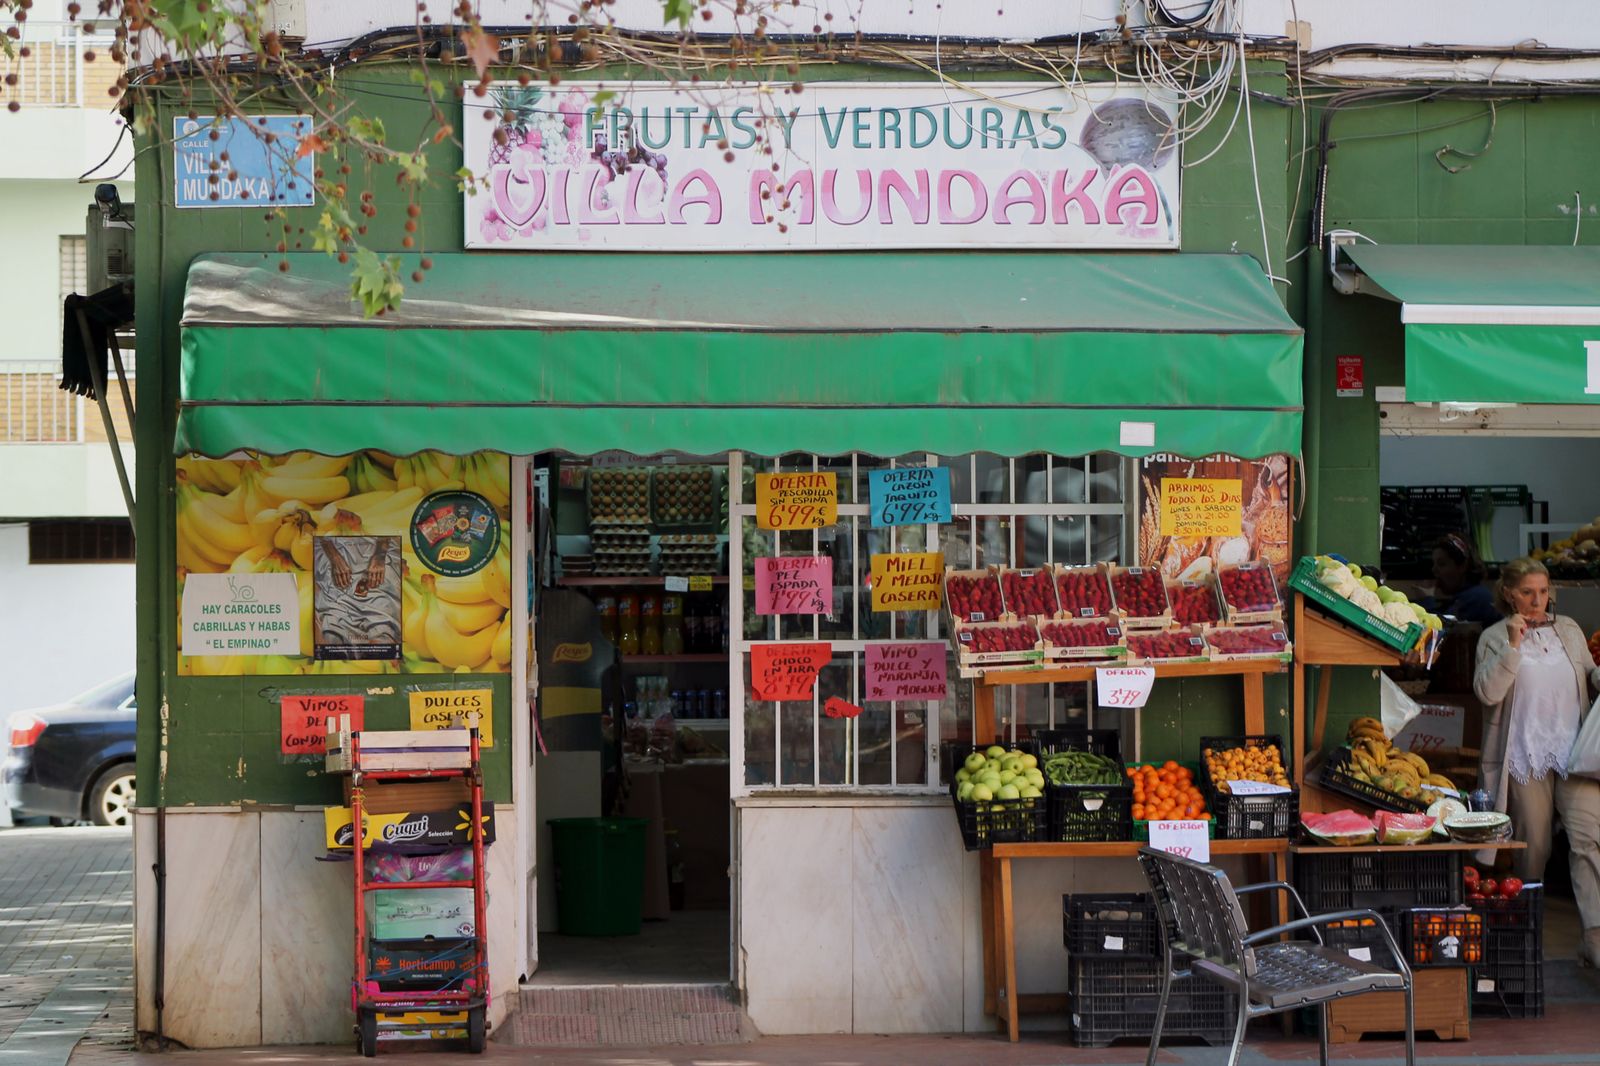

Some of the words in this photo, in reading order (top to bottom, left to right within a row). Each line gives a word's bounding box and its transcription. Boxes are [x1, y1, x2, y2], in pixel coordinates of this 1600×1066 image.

[585, 106, 757, 150] FRUTAS
[777, 107, 800, 150] Y
[818, 105, 1067, 150] VERDURAS
[182, 140, 209, 148] CALLE
[183, 152, 231, 174] VILLA
[184, 178, 270, 201] MUNDAKA
[494, 168, 722, 226] VILLA
[749, 163, 1160, 225] MUNDAKA
[770, 475, 827, 490] OFERTA
[884, 469, 934, 483] OFERTA
[892, 480, 931, 492] CAZON
[1168, 483, 1214, 494] ABRIMOS
[779, 489, 833, 497] PESCADILLA
[883, 490, 937, 503] TAQUITO
[1168, 496, 1196, 505] TODOS
[1201, 494, 1215, 504] LOS
[769, 505, 815, 527] 6'99
[882, 502, 925, 524] 6'99
[1170, 506, 1190, 514] LUNES
[768, 558, 818, 571] OFERTA
[887, 557, 932, 572] MIEL
[776, 570, 801, 580] PEZ
[770, 580, 818, 592] ESPADA
[876, 576, 882, 588] Y
[881, 590, 938, 604] CASERA
[202, 605, 221, 614] HAY
[224, 604, 281, 614] CARACOLES
[193, 622, 246, 631] CABRILLAS
[249, 622, 255, 631] Y
[258, 621, 291, 631] HABAS
[213, 639, 225, 649] EL
[228, 639, 271, 649] EMPINAO
[881, 646, 917, 659] VINO
[772, 656, 811, 666] CHOCO
[873, 662, 911, 672] DULCE
[922, 658, 932, 669] Y
[764, 667, 781, 677] EN
[878, 670, 940, 682] NARANJA
[872, 687, 886, 697] DE
[897, 683, 946, 695] MOGUER
[300, 699, 348, 711] VINOS
[425, 696, 481, 709] DULCES
[286, 734, 326, 747] CONDA
[382, 815, 429, 841] Cuqui
[399, 957, 456, 971] Horticampo
